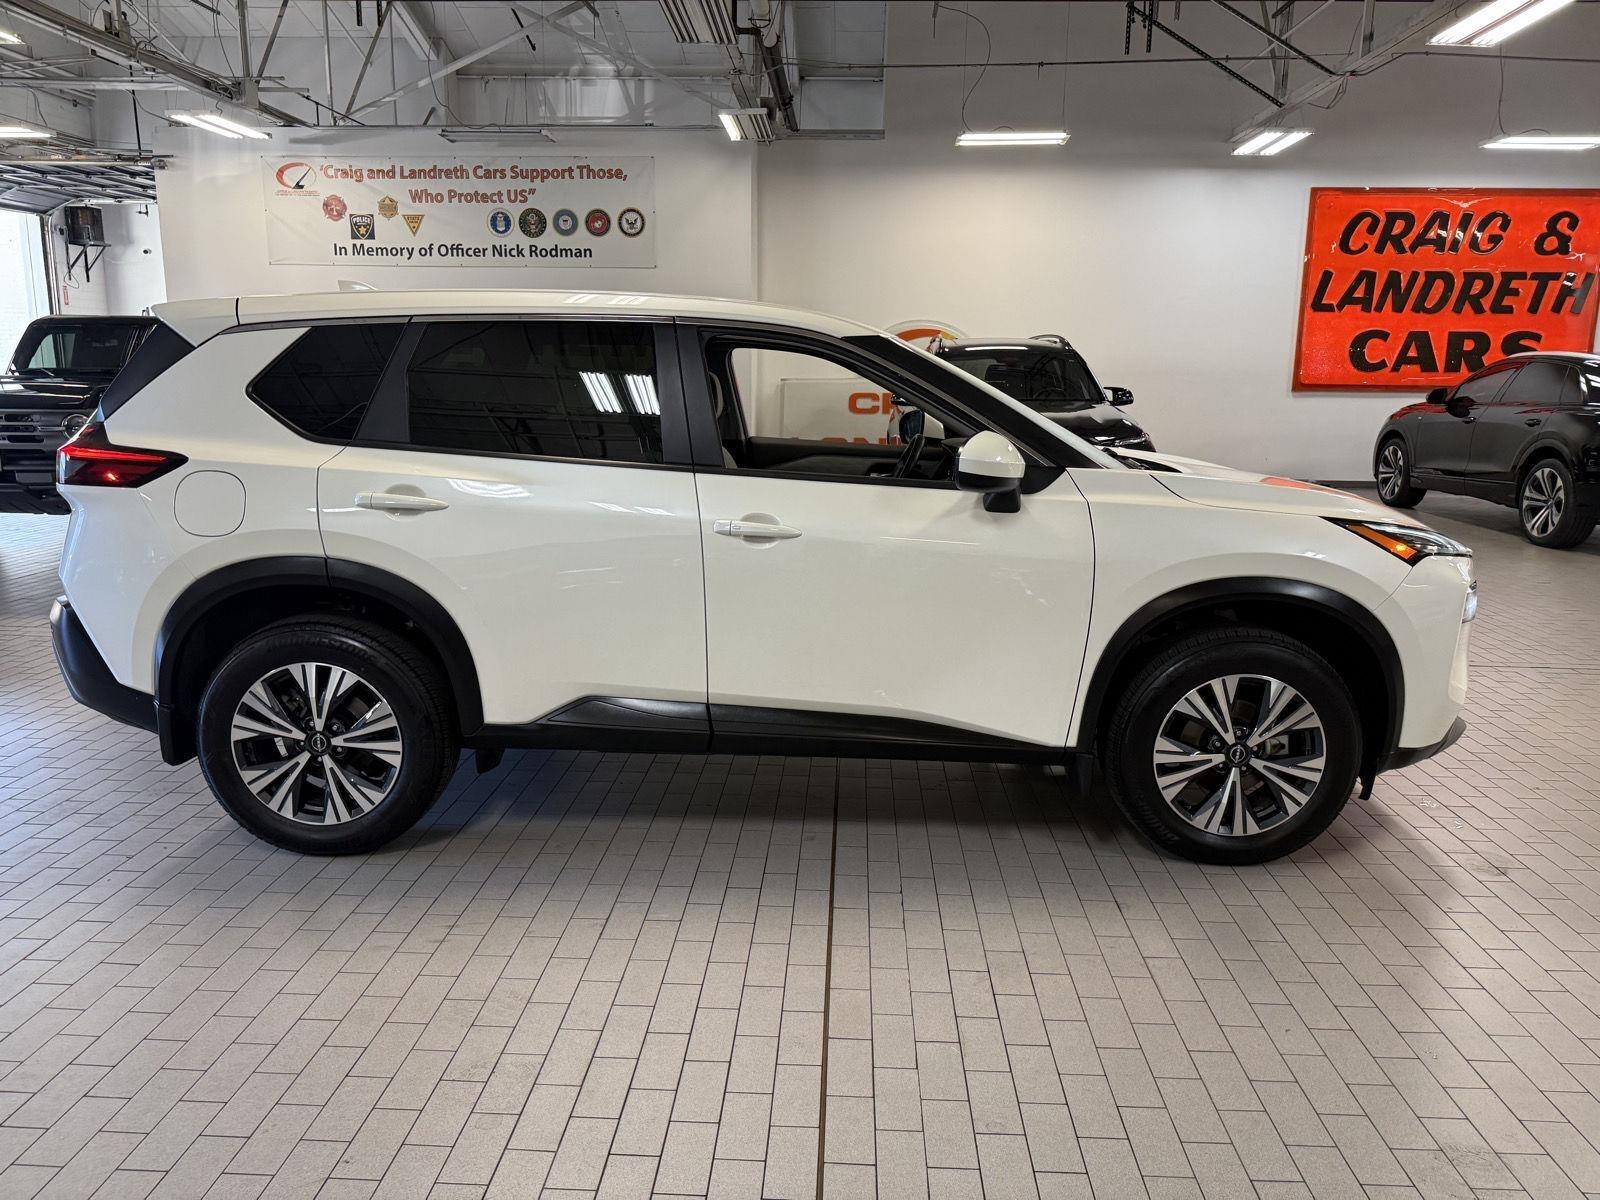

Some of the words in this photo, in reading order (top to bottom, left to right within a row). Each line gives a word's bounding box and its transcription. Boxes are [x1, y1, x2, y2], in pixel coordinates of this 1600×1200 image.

[367, 165, 396, 179] and
[400, 165, 469, 180] Landreth
[473, 165, 507, 180] Cars
[510, 165, 575, 182] Support
[577, 165, 627, 182] Those,
[409, 189, 444, 204] Who
[448, 189, 504, 204] Protect
[353, 216, 371, 224] POLICE
[1338, 209, 1512, 256] CRAIG
[1534, 210, 1580, 256] &
[334, 243, 347, 257] In
[352, 243, 415, 260] Memory
[418, 243, 434, 258] of
[438, 243, 488, 259] Officer
[492, 243, 526, 259] Nick
[529, 243, 592, 259] Rodman
[1310, 268, 1595, 315] LANDRETH
